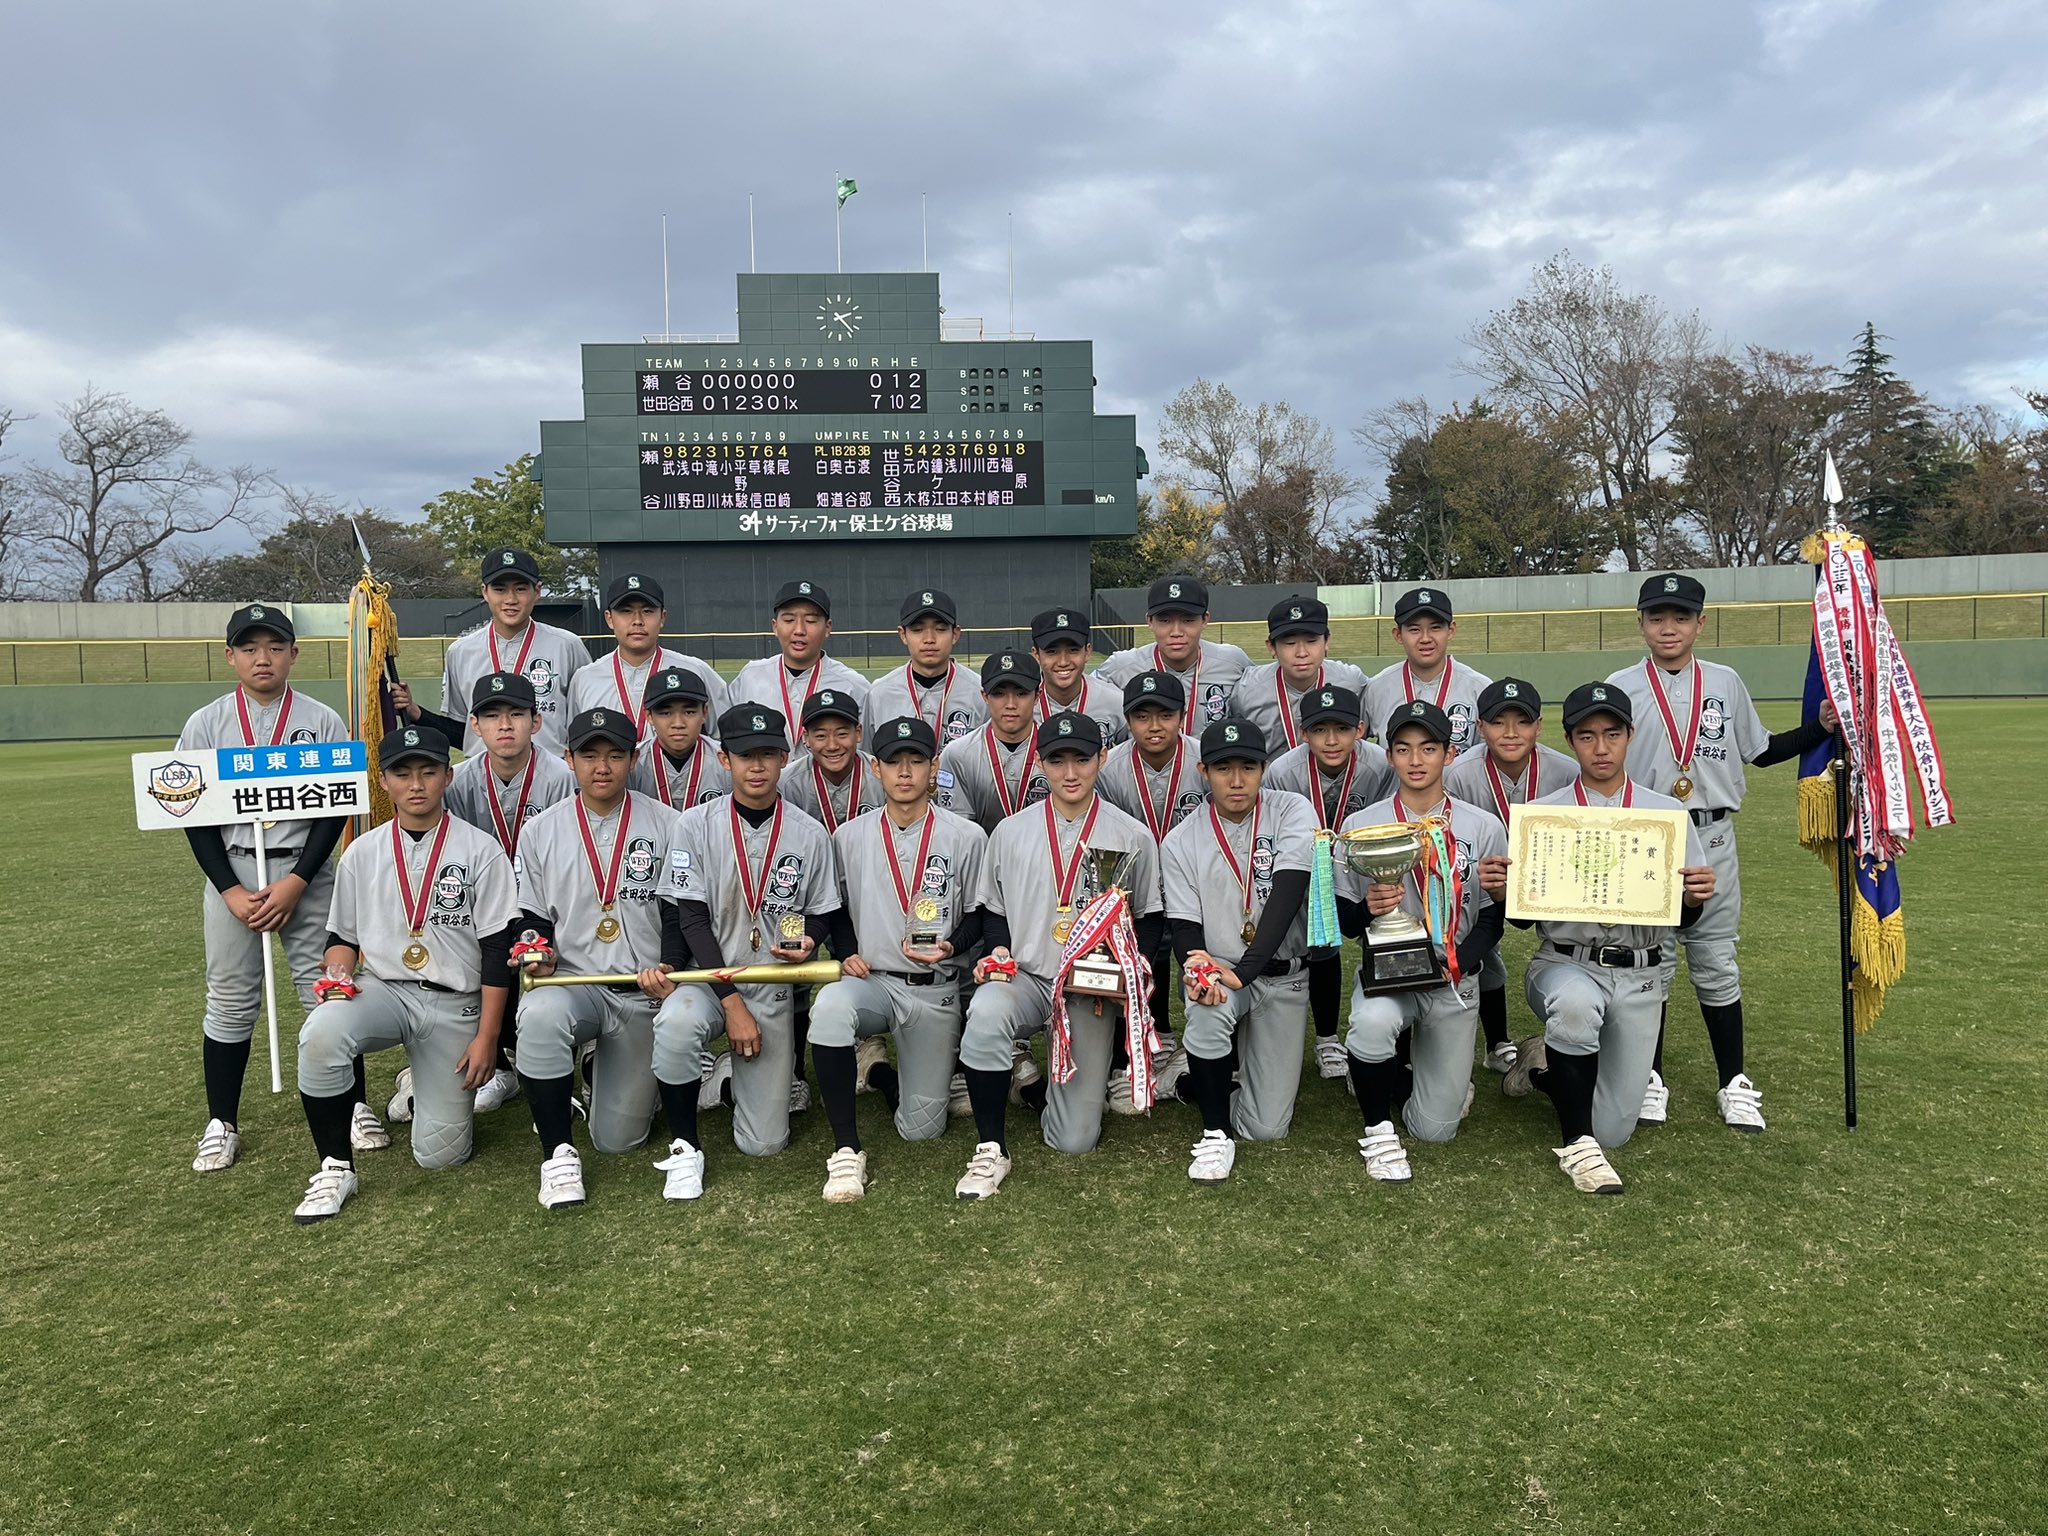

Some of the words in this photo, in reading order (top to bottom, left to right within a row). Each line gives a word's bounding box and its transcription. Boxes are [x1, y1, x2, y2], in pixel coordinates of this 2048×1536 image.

[646, 358, 682, 368] TEAM
[704, 359, 709, 368] 1
[720, 359, 726, 368] 2
[737, 358, 742, 368] 3
[752, 358, 759, 368] 4
[769, 358, 776, 368] 5
[785, 358, 791, 368] 6
[801, 358, 807, 368] 7
[817, 358, 824, 368] 8
[833, 358, 840, 368] 9
[847, 358, 858, 368] 10
[872, 358, 879, 367] R
[892, 358, 898, 367] H
[911, 358, 918, 366] E
[960, 370, 966, 378] B
[870, 373, 882, 388] 0
[892, 374, 900, 388] 1
[909, 373, 920, 388] 2
[961, 387, 966, 395] S
[643, 396, 694, 411] 世田谷西
[870, 394, 882, 410] 7
[890, 394, 904, 409] 10
[910, 394, 922, 409] 2
[960, 404, 967, 412] O
[642, 432, 658, 442] TN
[665, 433, 669, 441] 1
[679, 433, 685, 441] 2
[693, 432, 699, 441] 3
[708, 432, 714, 441] 4
[722, 432, 728, 441] 5
[736, 432, 742, 441] 6
[751, 432, 756, 441] 7
[765, 432, 771, 440] 8
[780, 432, 786, 440] 9
[816, 432, 869, 440] UMPIRE
[883, 430, 899, 440] TN
[906, 431, 910, 440] 1
[920, 431, 926, 440] 2
[934, 431, 940, 440] 3
[948, 431, 954, 439] 4
[962, 430, 968, 439] 5
[976, 430, 982, 439] 6
[990, 430, 995, 439] 7
[1003, 430, 1009, 439] 8
[1017, 430, 1023, 439] 9
[882, 448, 900, 506] 世田谷西
[1095, 494, 1115, 504] km/h
[530, 673, 550, 682] WEST
[1703, 714, 1721, 724] WEST
[233, 748, 352, 772] 関東連盟
[232, 782, 358, 814] 世田谷西
[630, 856, 651, 866] WEST
[1254, 856, 1274, 866] WEST
[778, 872, 796, 883] WEST
[924, 872, 945, 883] WEST
[440, 883, 461, 893] WEST
[618, 886, 657, 901] 世田谷西
[428, 912, 471, 927] 世田谷西
